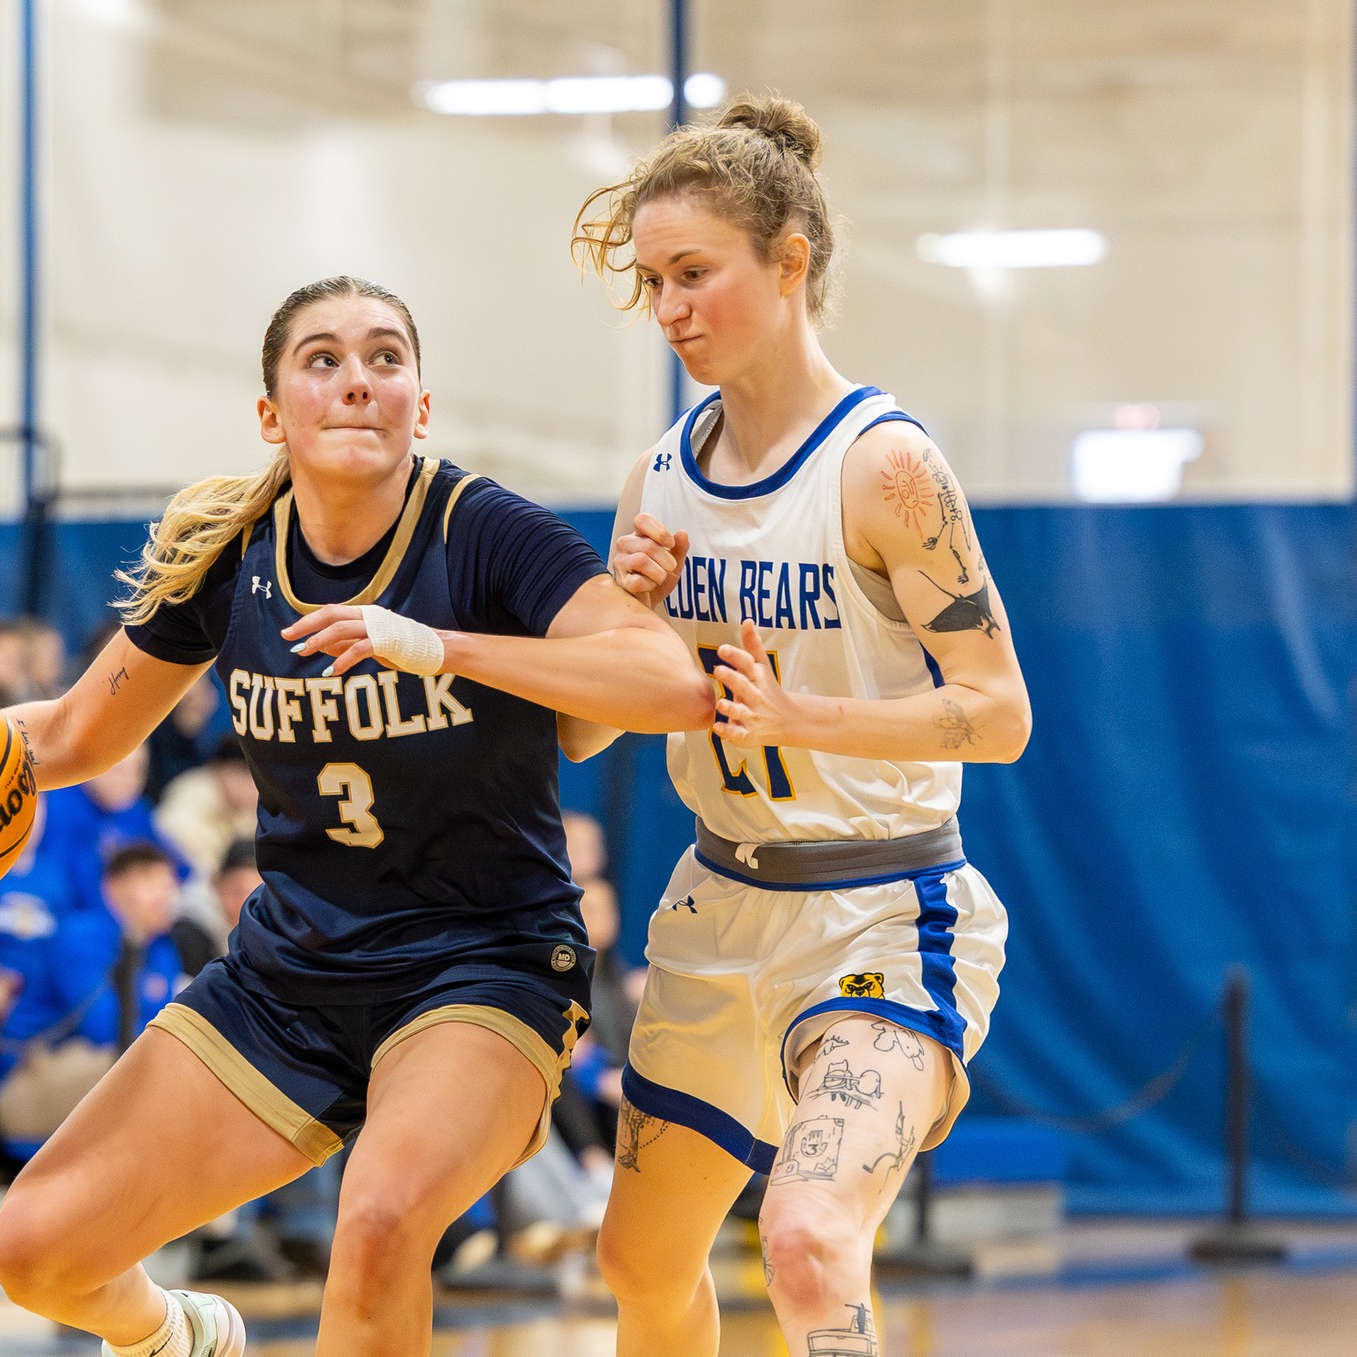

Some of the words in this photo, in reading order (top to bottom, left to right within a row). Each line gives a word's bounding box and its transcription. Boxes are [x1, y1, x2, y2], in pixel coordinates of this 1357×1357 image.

[665, 556, 728, 624] LDEN
[739, 560, 842, 630] BEARS
[230, 668, 474, 743] SUFFOLK
[696, 643, 796, 801] 21
[317, 762, 385, 849] 3
